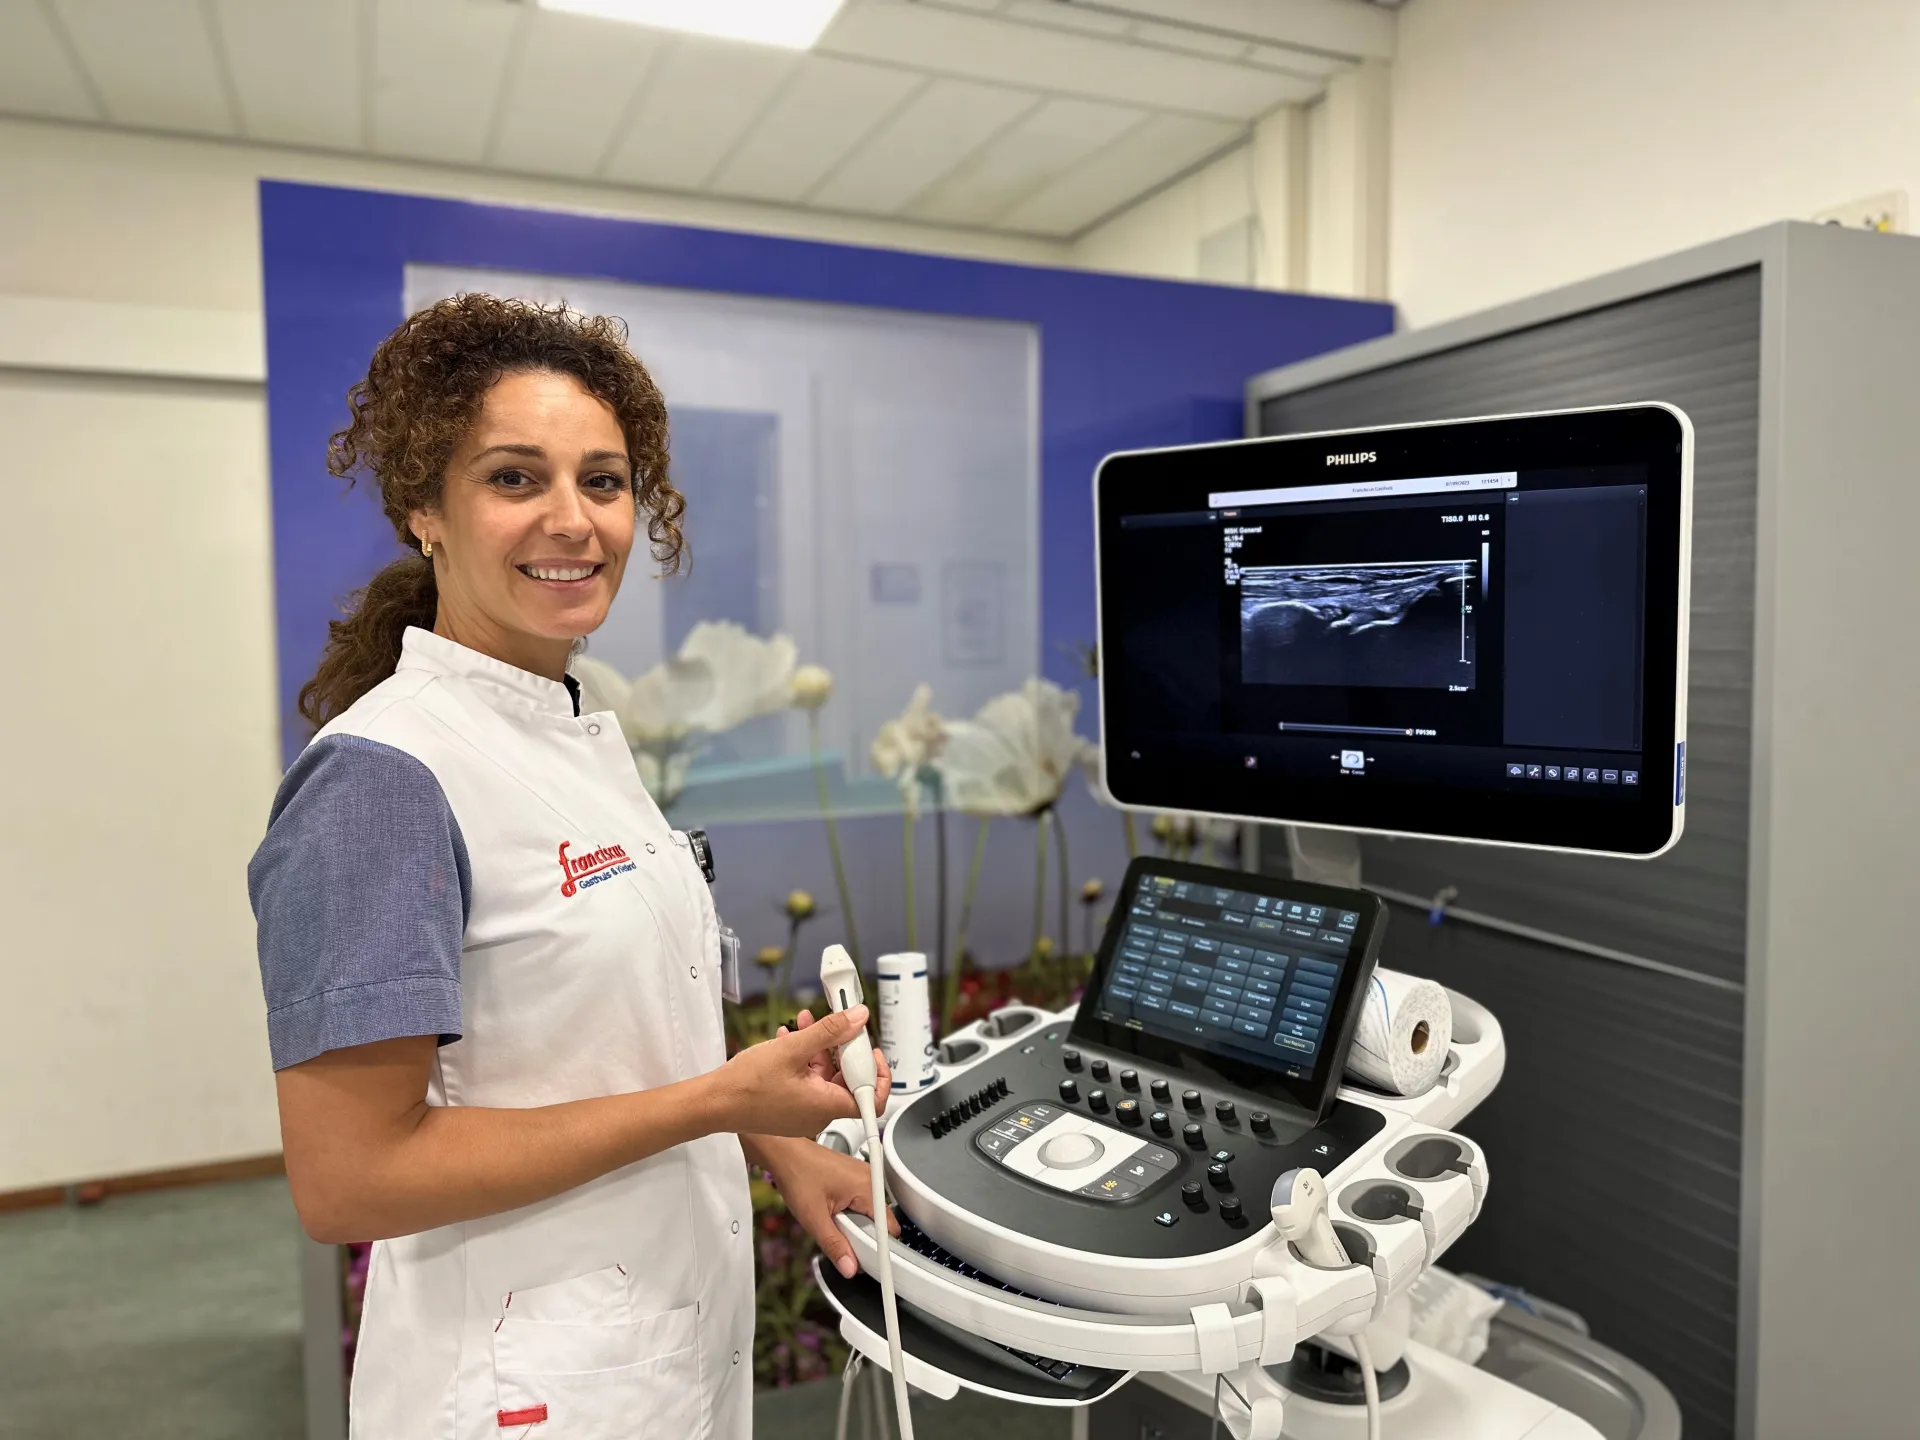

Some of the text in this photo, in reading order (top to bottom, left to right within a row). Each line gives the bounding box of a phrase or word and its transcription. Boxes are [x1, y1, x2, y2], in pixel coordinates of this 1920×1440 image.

[1326, 451, 1377, 466] PHILIPS
[1468, 514, 1477, 522] MI
[1224, 526, 1262, 535] MSK General
[579, 871, 612, 889] Gasthuis
[610, 867, 618, 876] &
